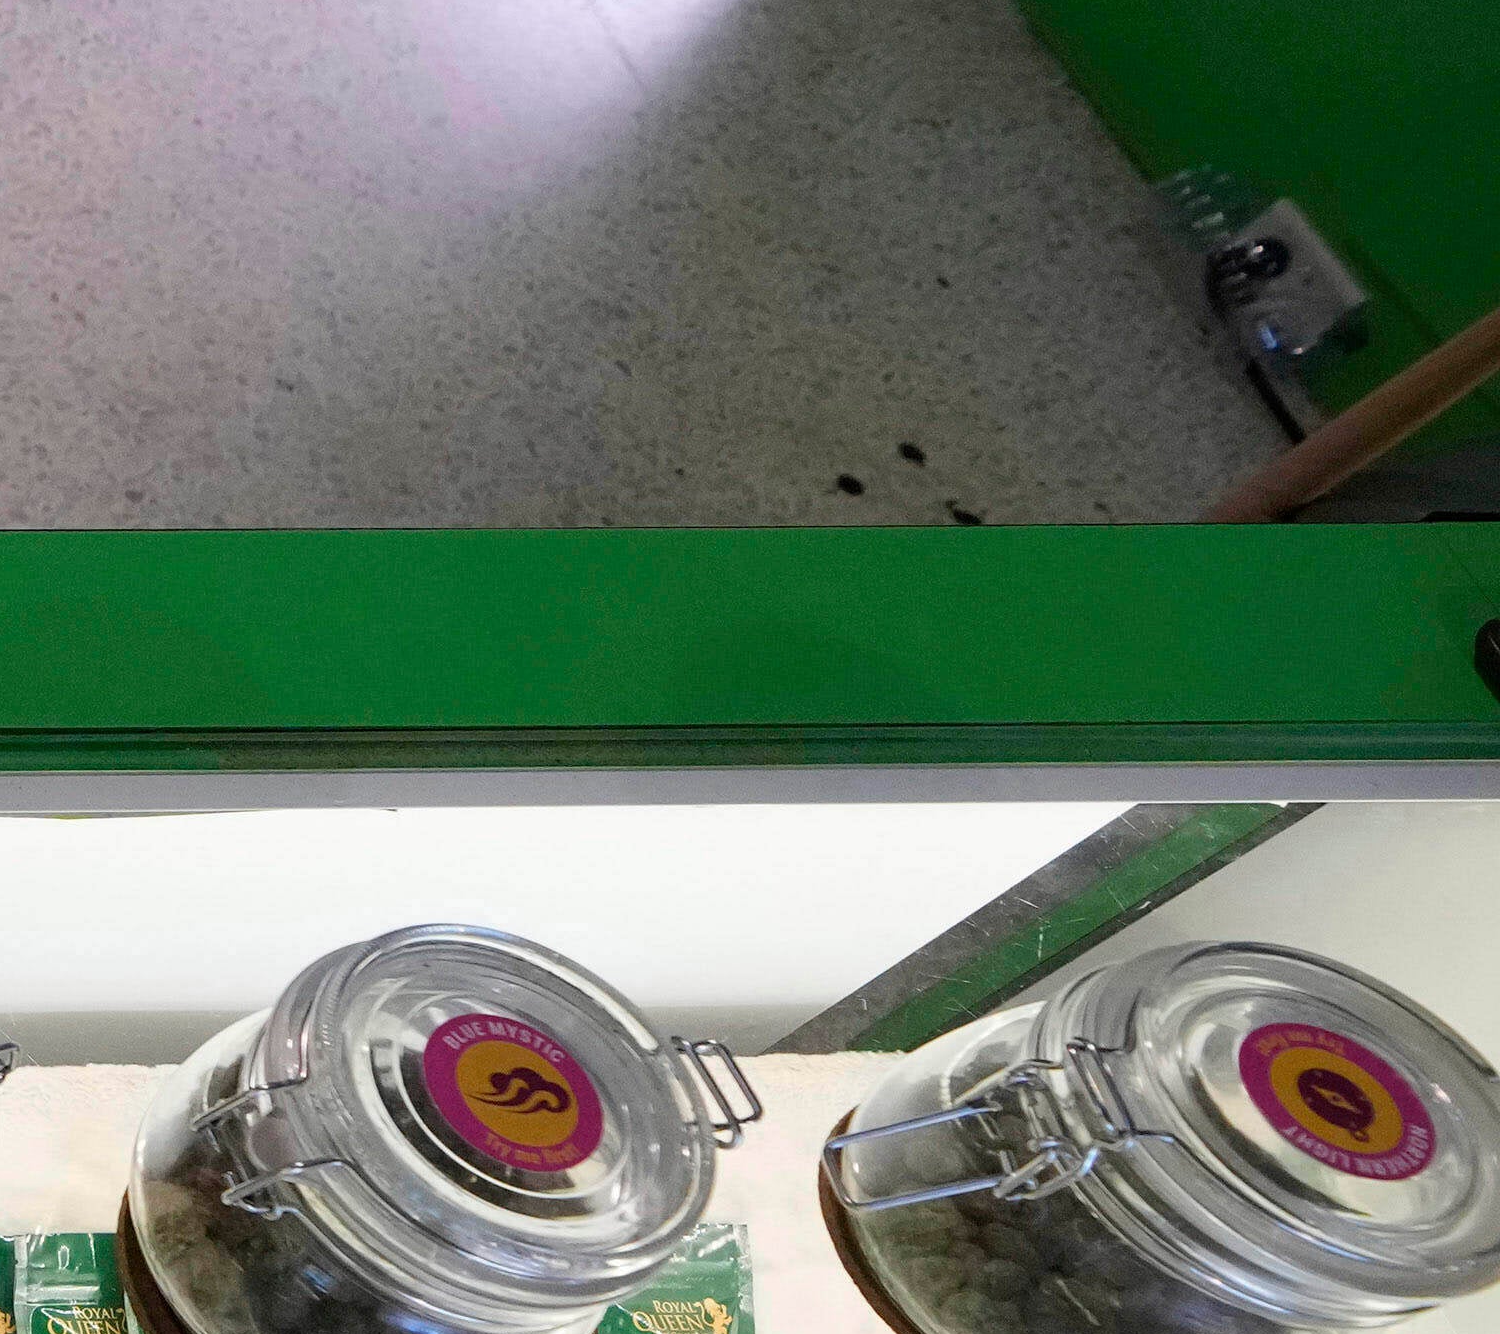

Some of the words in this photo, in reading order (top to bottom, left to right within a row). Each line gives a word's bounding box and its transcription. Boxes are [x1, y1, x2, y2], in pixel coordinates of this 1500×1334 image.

[442, 1022, 486, 1050] BLUE
[487, 1021, 567, 1063] MYSTIC
[73, 1306, 119, 1321] ROYAL
[653, 1300, 699, 1314] ROYAL
[632, 1311, 704, 1332] QUEEN
